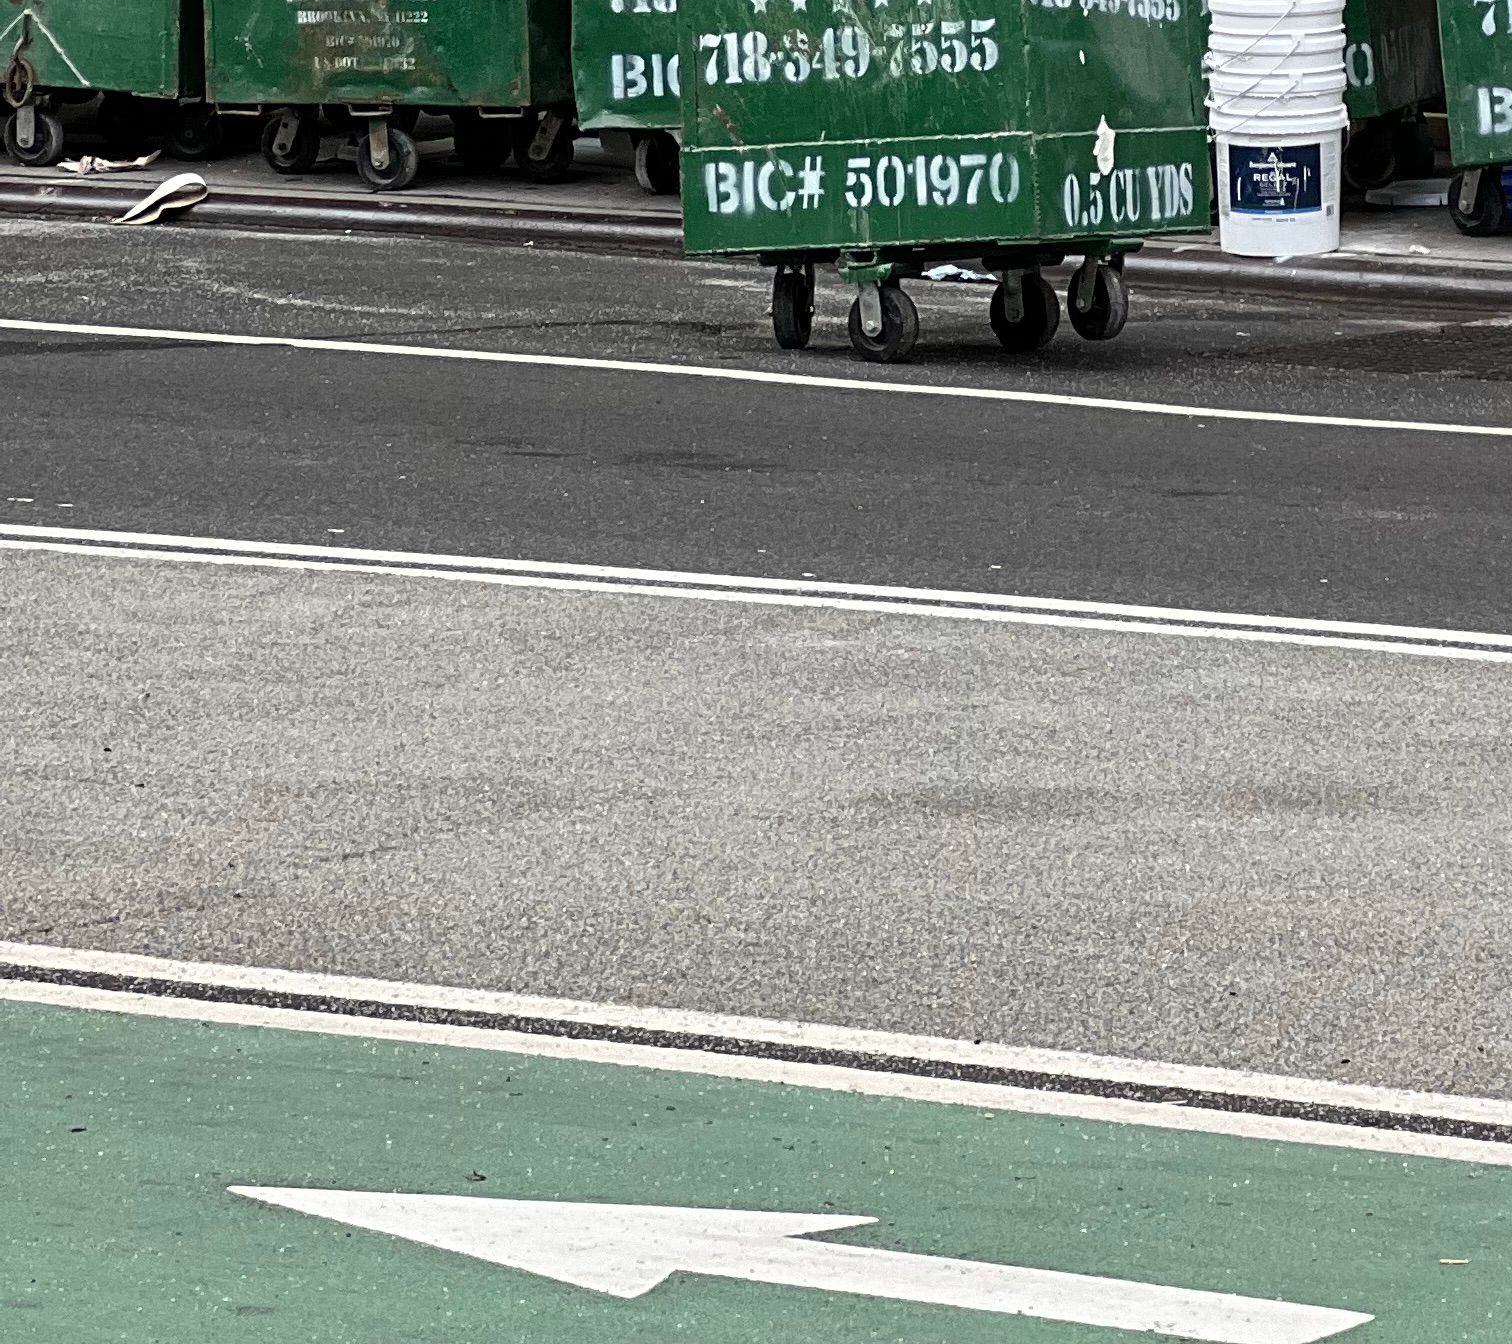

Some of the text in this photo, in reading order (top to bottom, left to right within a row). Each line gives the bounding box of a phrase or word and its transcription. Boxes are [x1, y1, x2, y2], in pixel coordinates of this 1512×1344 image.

[699, 18, 999, 88] 718-349-7555
[704, 152, 1020, 213] BIC# 501970
[1063, 172, 1103, 228] 0.5
[1108, 167, 1141, 223] CU
[1147, 162, 1194, 219] YDS
